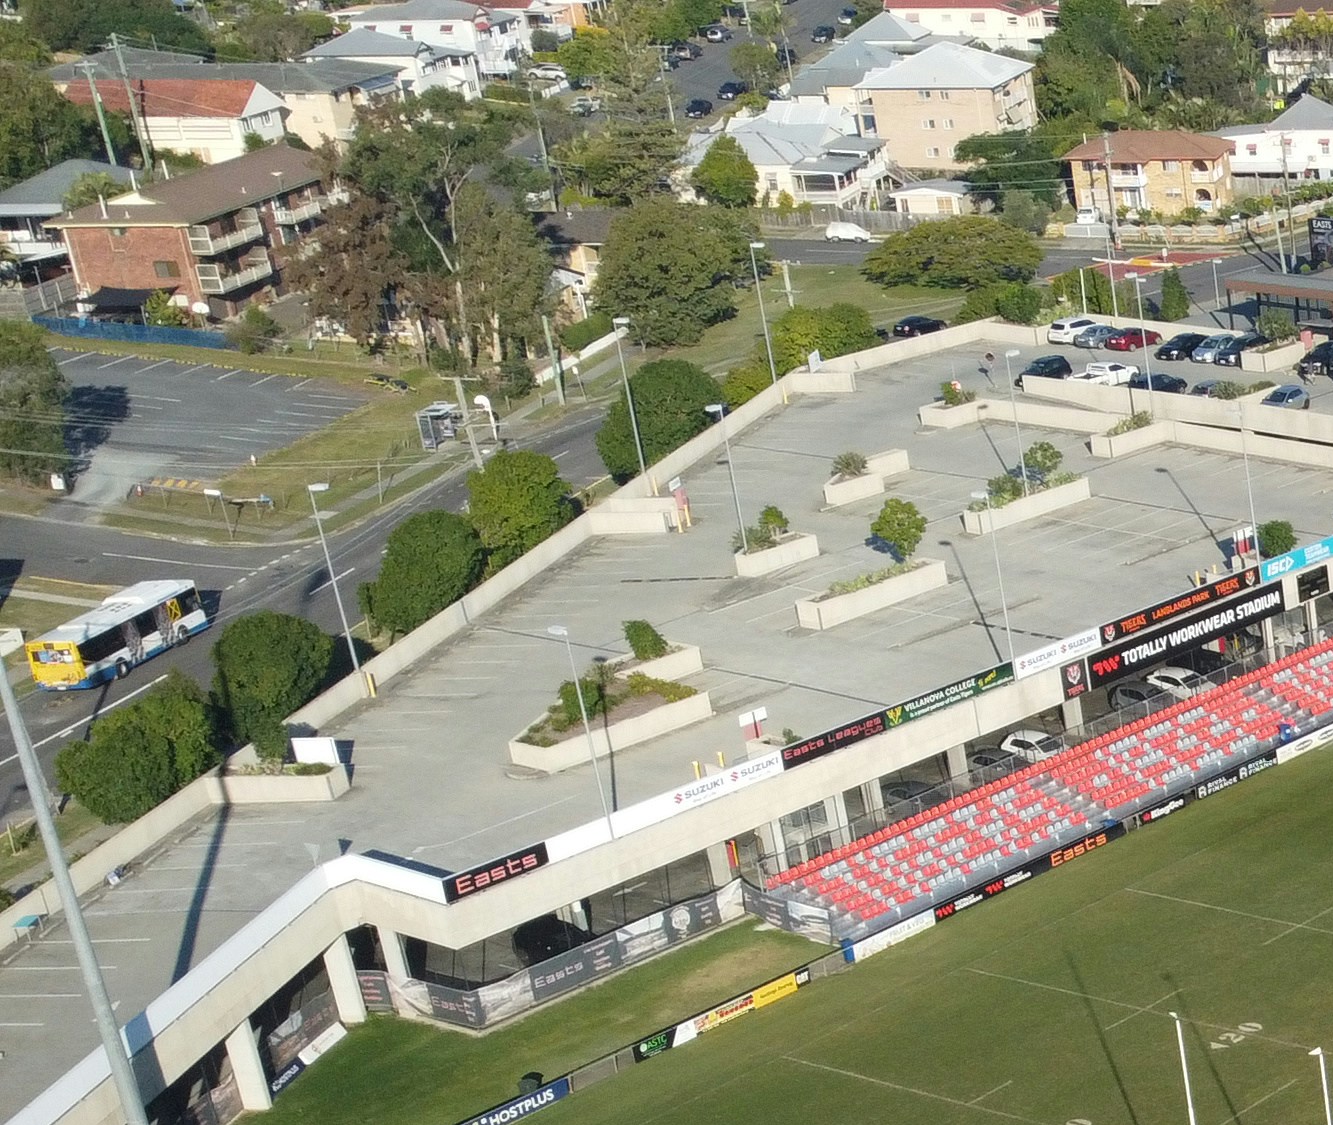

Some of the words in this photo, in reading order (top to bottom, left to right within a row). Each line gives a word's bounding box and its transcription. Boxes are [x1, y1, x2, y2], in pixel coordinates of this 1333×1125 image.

[1312, 219, 1332, 229] EASTS
[1215, 578, 1240, 595] TIGERS
[1152, 598, 1192, 620] LANGLANDS
[1192, 591, 1211, 604] PARK
[1120, 613, 1147, 633] TIGERS
[1121, 635, 1167, 666] TOTALLY
[1170, 611, 1236, 647] WORKWEAR
[1236, 591, 1281, 620] STADIUM
[1067, 634, 1097, 650] SUZUKI
[1027, 649, 1058, 666] SUZUKI
[903, 690, 945, 712] VILLANOVA
[945, 678, 977, 696] COLLEGE
[783, 738, 825, 760] Easts
[827, 716, 882, 744] Leagues
[740, 756, 779, 777] SUZUKI
[684, 777, 724, 799] SUZUKI
[1051, 832, 1108, 867] Easts
[455, 852, 539, 896] Easts
[534, 961, 584, 989] Easts
[647, 1033, 668, 1049] ASTC
[1218, 1022, 1264, 1044] 20
